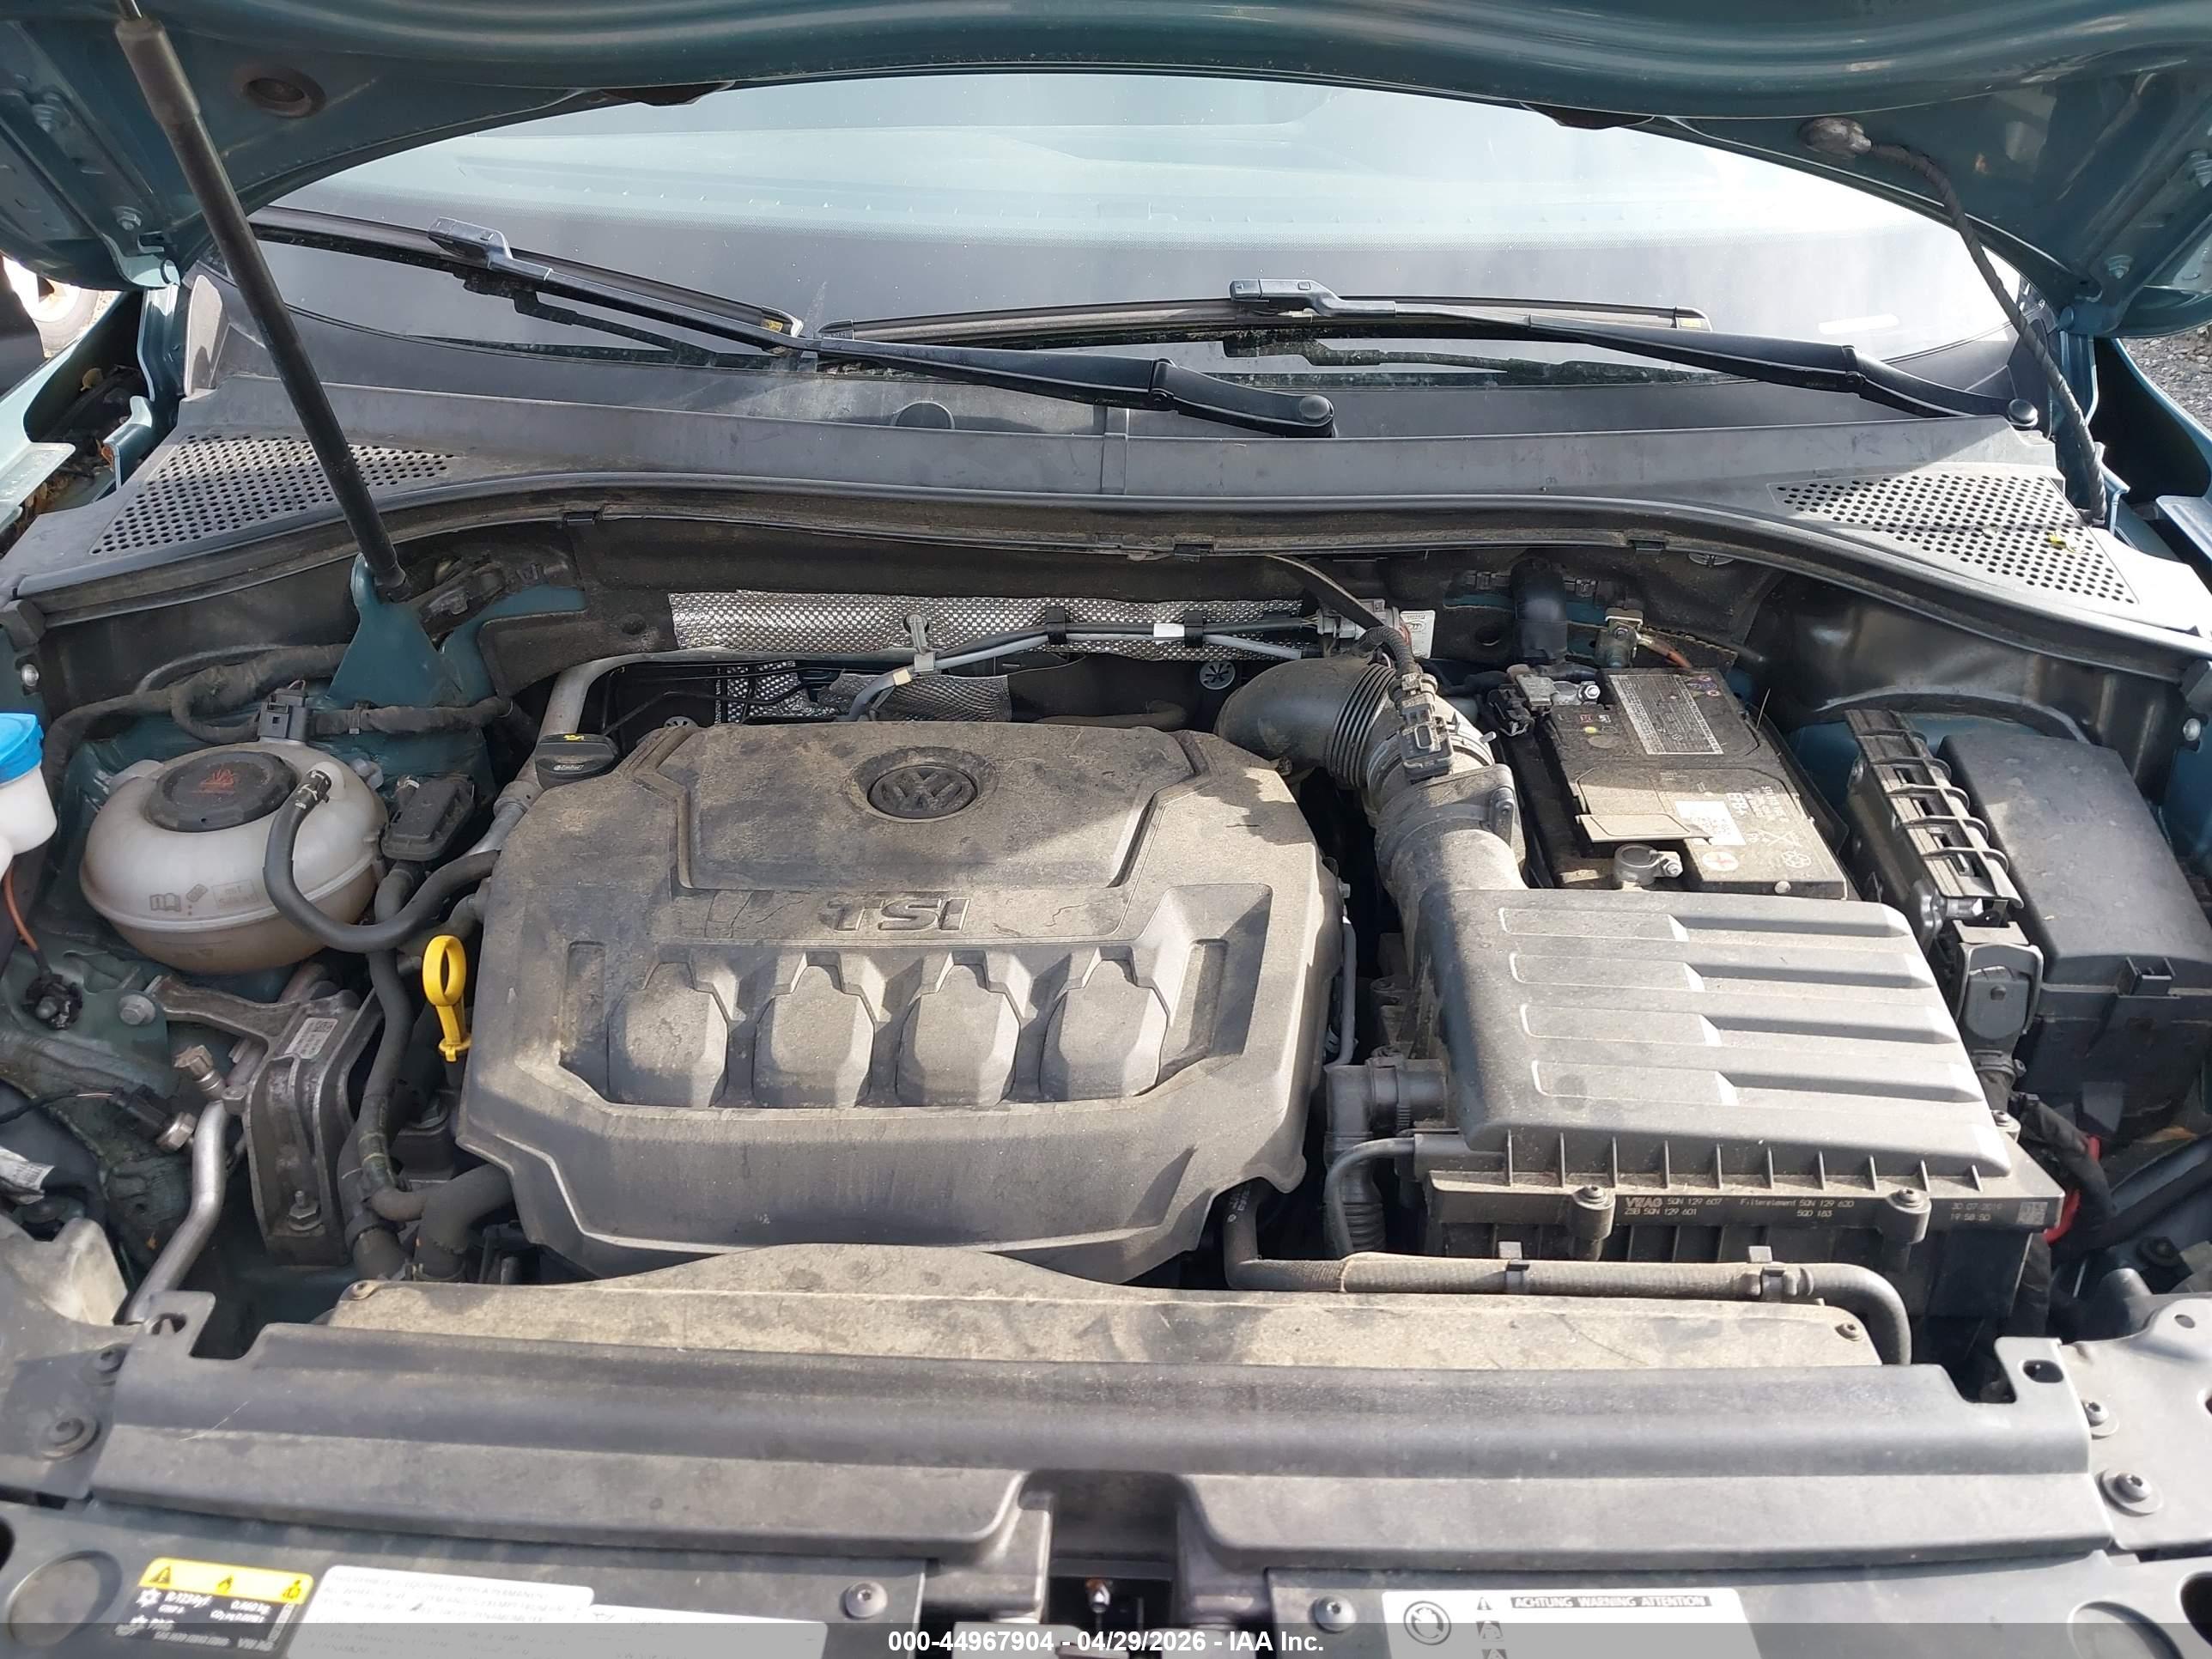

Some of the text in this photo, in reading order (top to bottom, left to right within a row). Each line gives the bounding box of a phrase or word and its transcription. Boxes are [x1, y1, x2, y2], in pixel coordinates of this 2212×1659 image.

[827, 896, 972, 932] TSI
[1664, 1207, 1680, 1216] 129
[1682, 1207, 1697, 1216] 601
[1514, 1595, 1706, 1607] ACHTUNG WARNING ATTENTION
